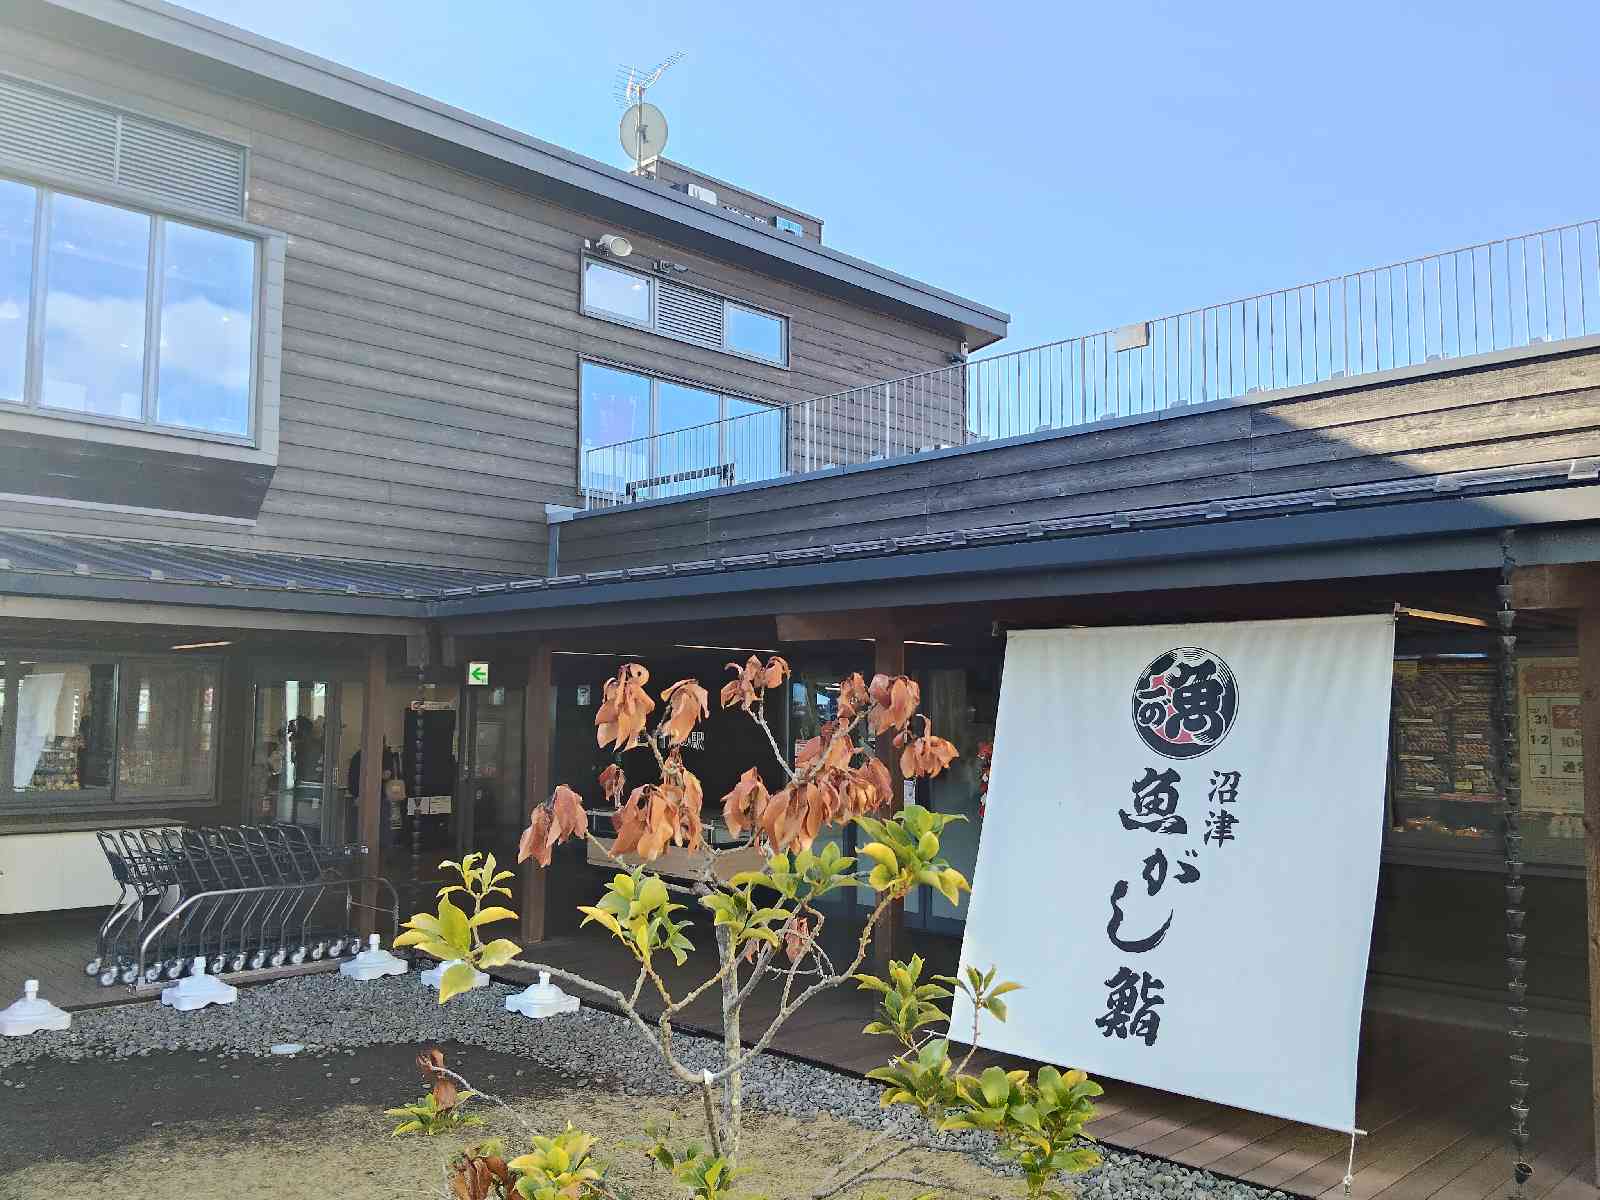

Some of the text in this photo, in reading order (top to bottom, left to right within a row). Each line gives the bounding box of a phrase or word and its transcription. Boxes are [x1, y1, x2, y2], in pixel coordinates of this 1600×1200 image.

[1204, 770, 1241, 848] 沼津
[1095, 767, 1200, 1046] 魚がし鮨
